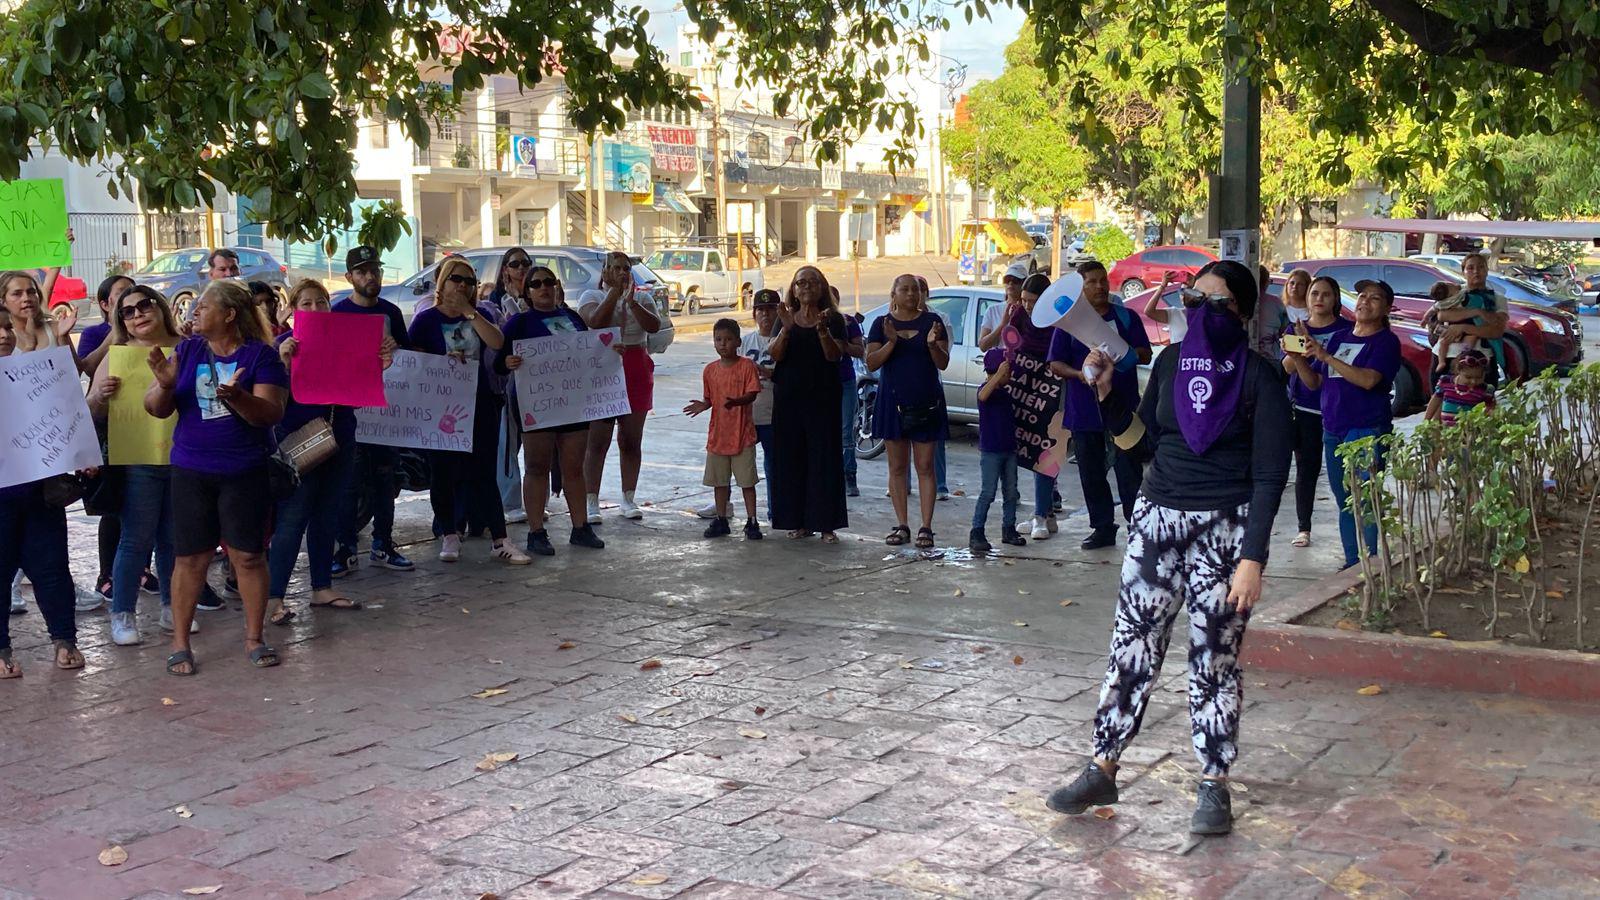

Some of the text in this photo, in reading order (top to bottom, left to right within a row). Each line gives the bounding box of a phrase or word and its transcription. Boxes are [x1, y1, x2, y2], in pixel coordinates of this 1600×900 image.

[0, 182, 57, 204] CIA!
[0, 239, 63, 257] atriz
[577, 337, 593, 349] EL
[394, 356, 417, 369] CHA
[587, 357, 603, 369] DE
[1016, 354, 1043, 372] HOY
[1181, 357, 1212, 371] ESTAS
[529, 382, 554, 394] LAS
[561, 378, 582, 390] QUE
[1031, 378, 1060, 398] VOZ
[406, 406, 432, 421] MAS
[606, 400, 628, 416] ANA
[1012, 404, 1038, 424] ITO
[1015, 427, 1051, 450] ENDO
